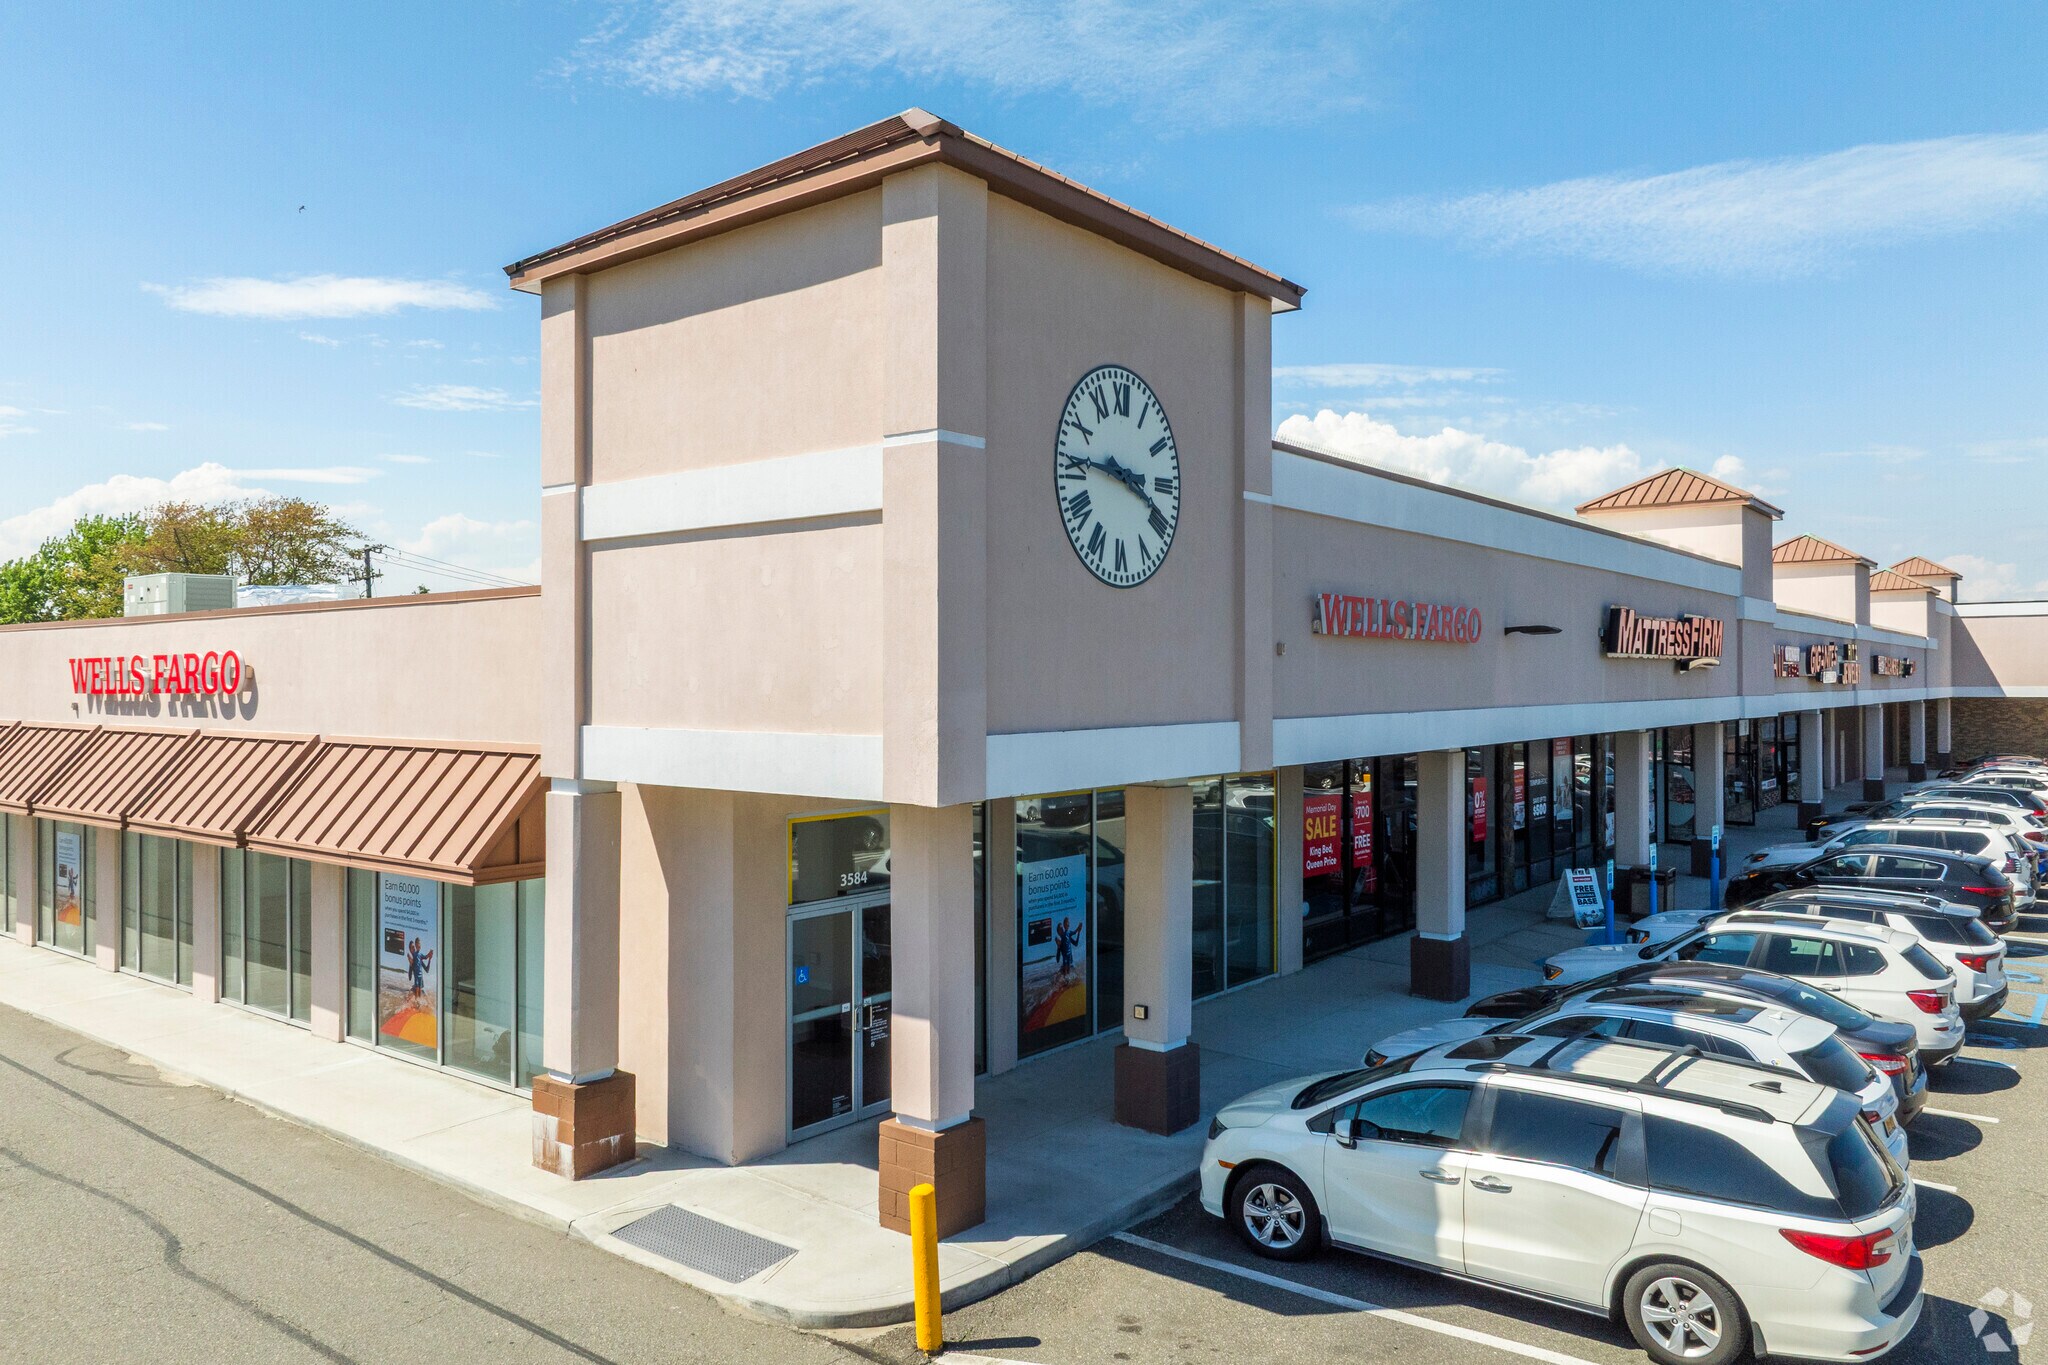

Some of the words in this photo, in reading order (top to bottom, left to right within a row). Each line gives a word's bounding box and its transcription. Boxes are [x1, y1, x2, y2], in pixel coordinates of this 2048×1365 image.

[1319, 593, 1408, 639] WELLS
[1411, 602, 1482, 644] FARGO
[69, 655, 146, 695] WELLS
[152, 650, 241, 695] FARGO
[1474, 790, 1485, 809] 0%
[1306, 804, 1327, 814] Memorial
[1328, 803, 1336, 813] Day
[1355, 805, 1370, 819] $700
[1306, 815, 1337, 841] SALE
[1354, 833, 1371, 849] FREE
[1309, 846, 1321, 857] King
[1322, 843, 1333, 854] Bed,
[1306, 859, 1323, 870] Queen
[1324, 856, 1337, 867] Price
[840, 870, 868, 887] 3584
[1028, 872, 1044, 882] Earn
[1045, 866, 1068, 880] 60,000
[385, 880, 398, 891] Earn
[399, 882, 420, 895] 60,000
[1028, 884, 1049, 895] bonus
[1050, 880, 1070, 894] points
[1574, 885, 1595, 893] FREE
[385, 893, 402, 904] bonus
[403, 896, 422, 908] points
[1577, 897, 1598, 905] BASE
